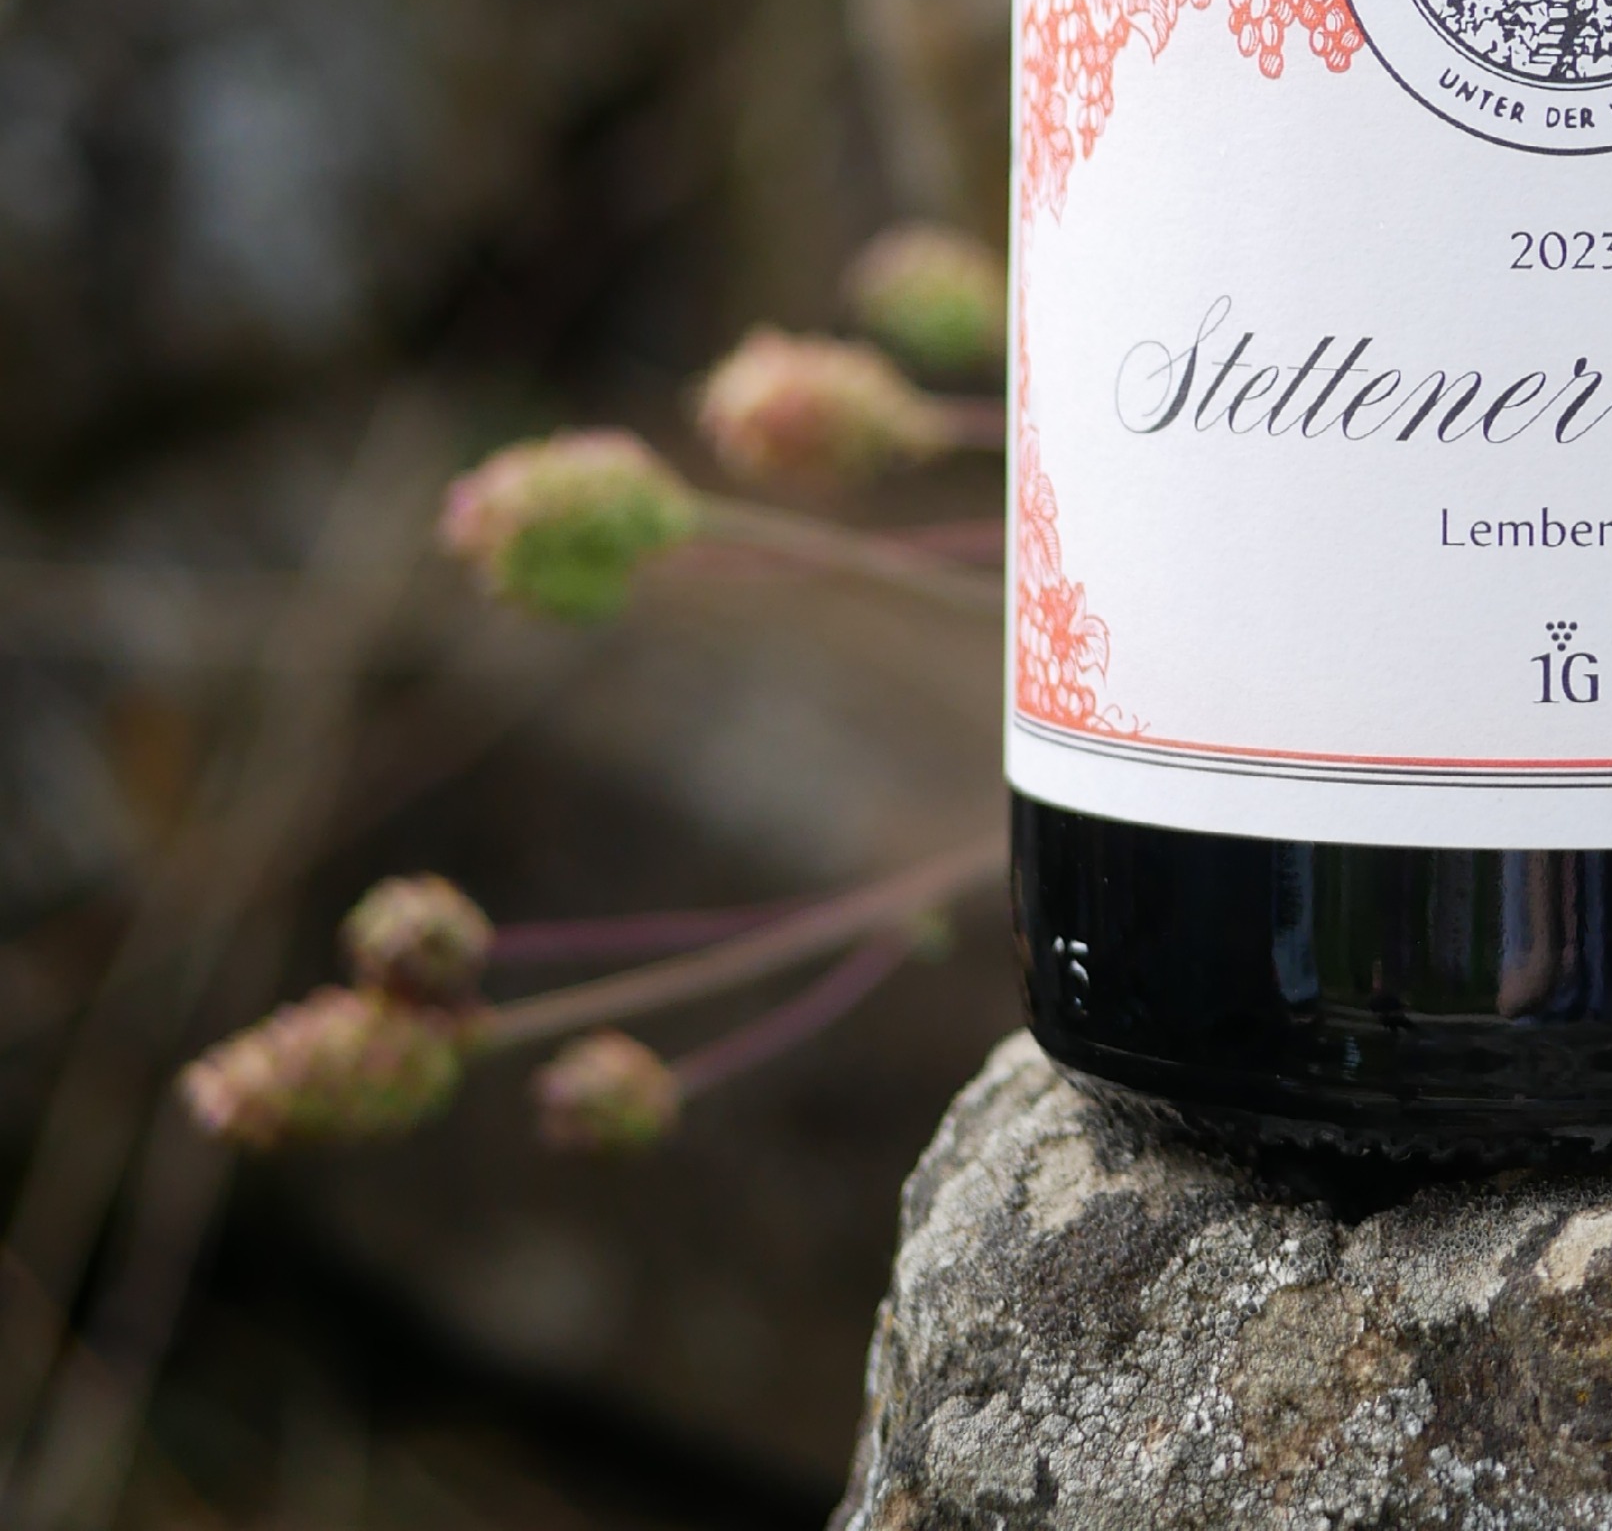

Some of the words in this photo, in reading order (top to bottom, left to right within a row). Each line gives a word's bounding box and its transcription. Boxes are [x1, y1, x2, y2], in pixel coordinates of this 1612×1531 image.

[1438, 68, 1525, 123] UNTER
[1545, 107, 1595, 129] DER
[1530, 651, 1600, 704] 1G
